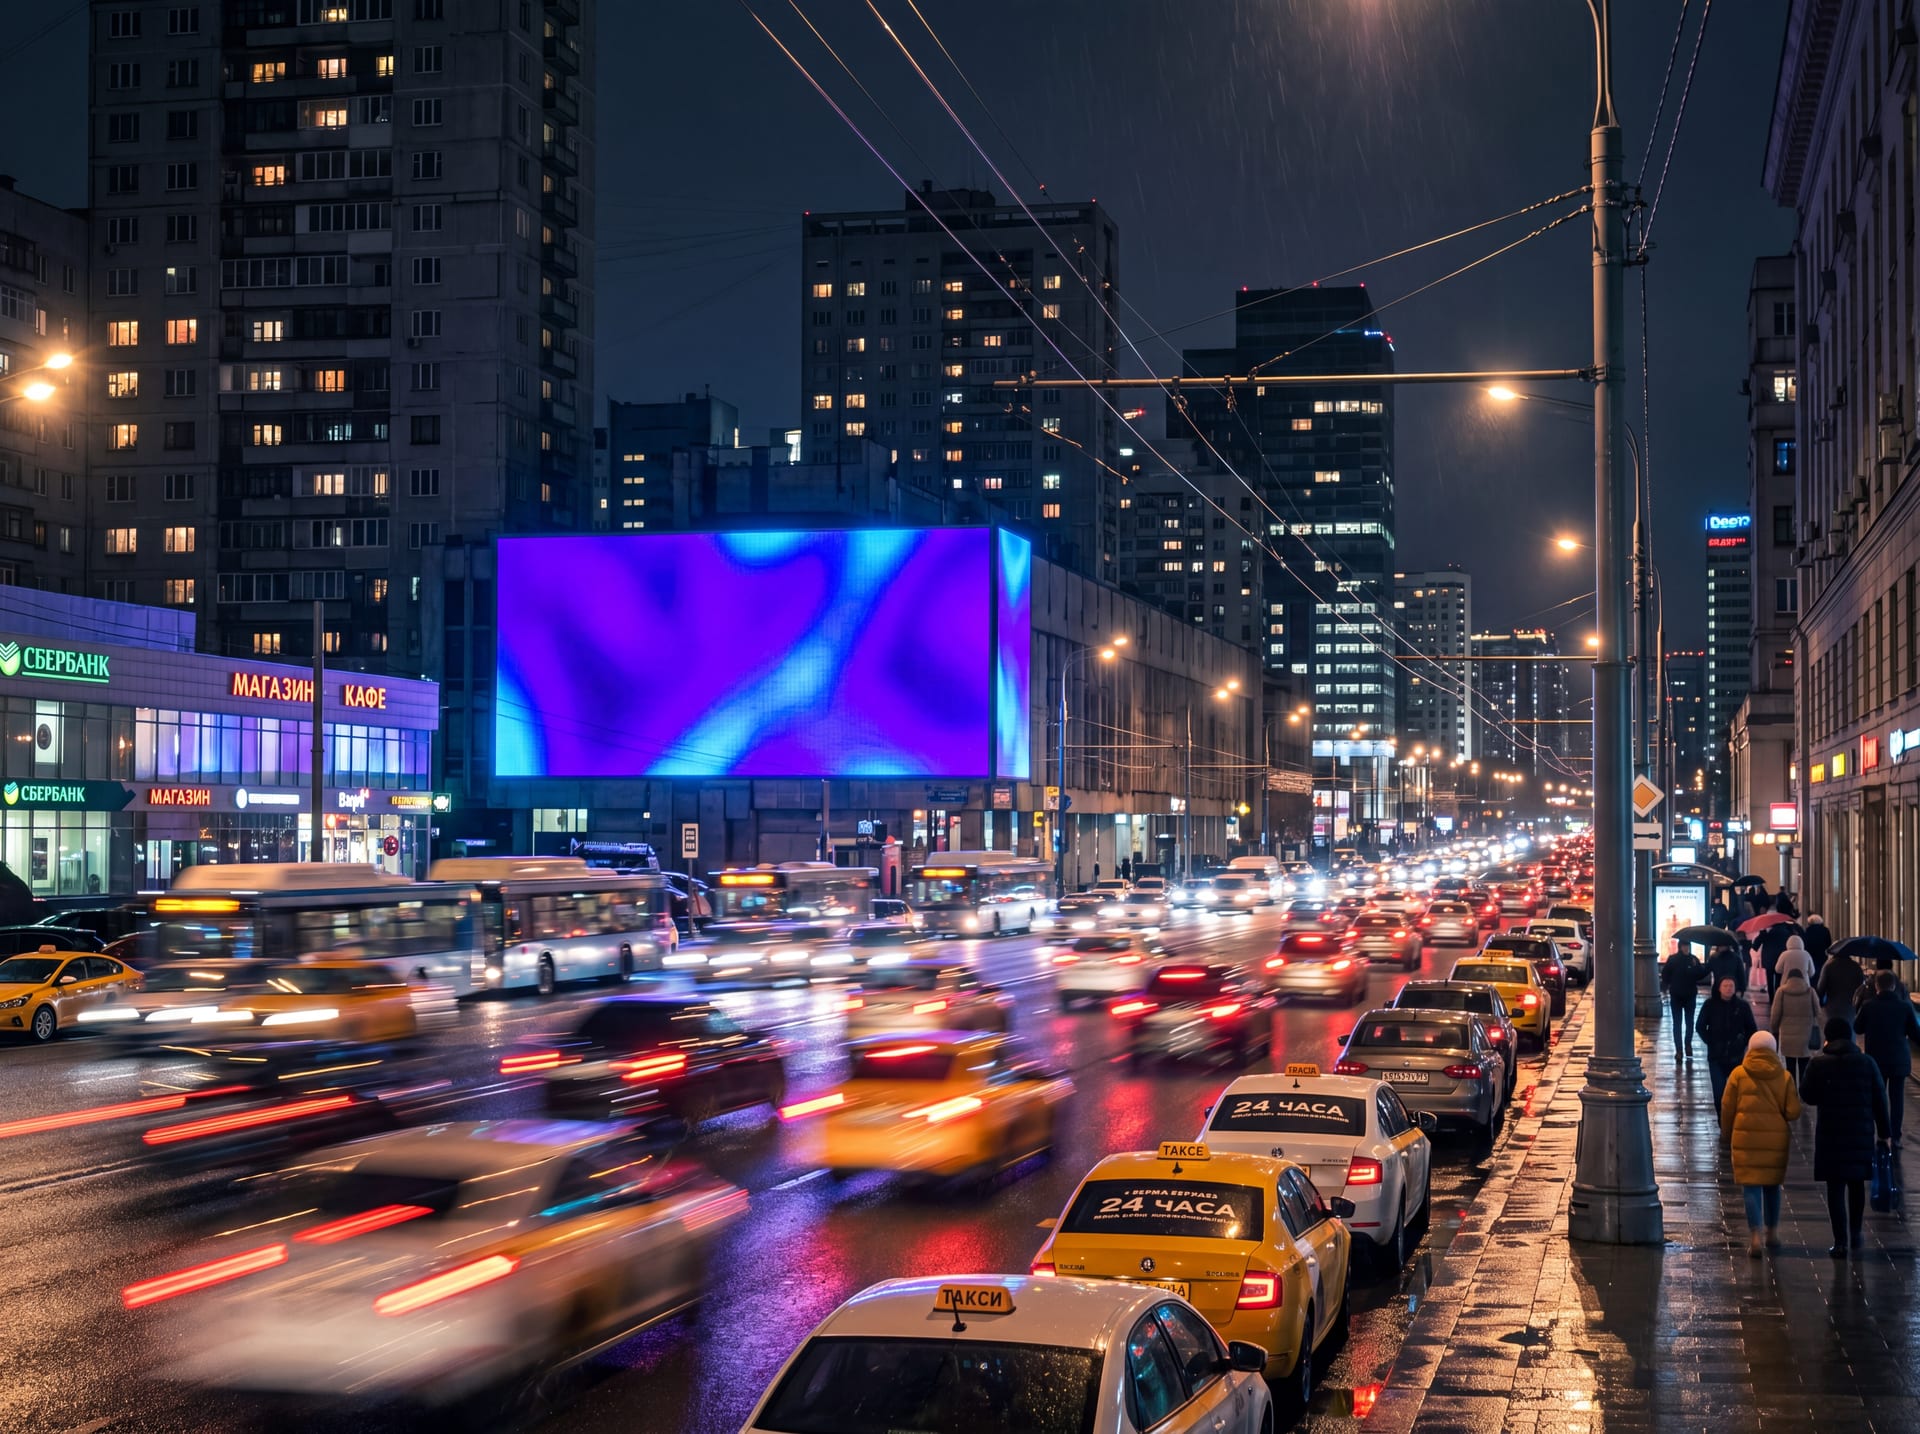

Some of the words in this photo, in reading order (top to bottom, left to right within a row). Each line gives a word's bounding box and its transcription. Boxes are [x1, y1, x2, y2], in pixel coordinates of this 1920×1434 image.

[23, 646, 110, 677] СБЕРБАНК
[233, 672, 314, 703] МАГАЗИН
[344, 684, 387, 709] КАФЕ
[21, 785, 85, 802] СБЕРБАНК
[150, 788, 211, 806] МАГАЗИН
[1233, 1100, 1271, 1114] 24
[1278, 1101, 1344, 1117] ЧАСА
[1100, 1197, 1144, 1213] 24
[1155, 1199, 1236, 1218] ЧАСА
[942, 1289, 1003, 1307] ТАКСИ
